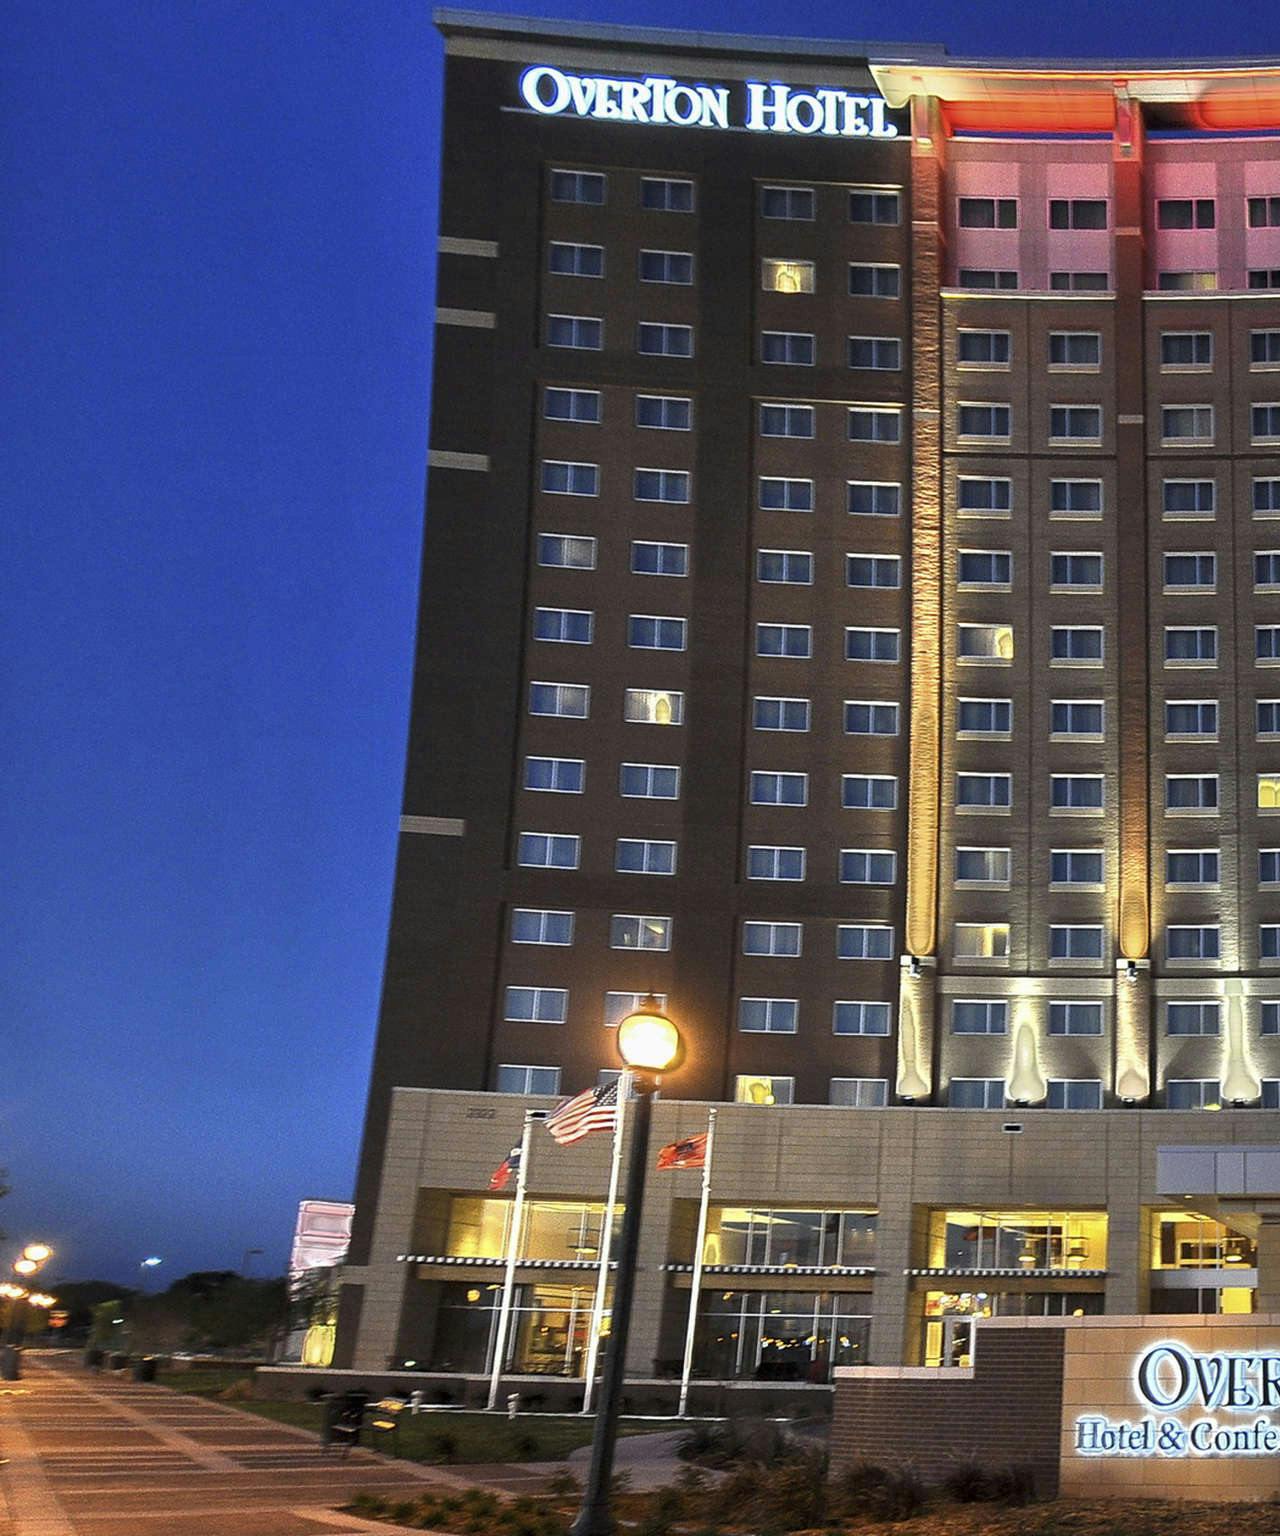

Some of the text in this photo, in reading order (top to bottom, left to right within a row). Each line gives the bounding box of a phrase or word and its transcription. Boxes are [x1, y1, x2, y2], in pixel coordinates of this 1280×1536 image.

[520, 66, 899, 138] OVERTON HOTEL
[1075, 1419, 1154, 1452] Hotel
[1157, 1421, 1185, 1452] &
